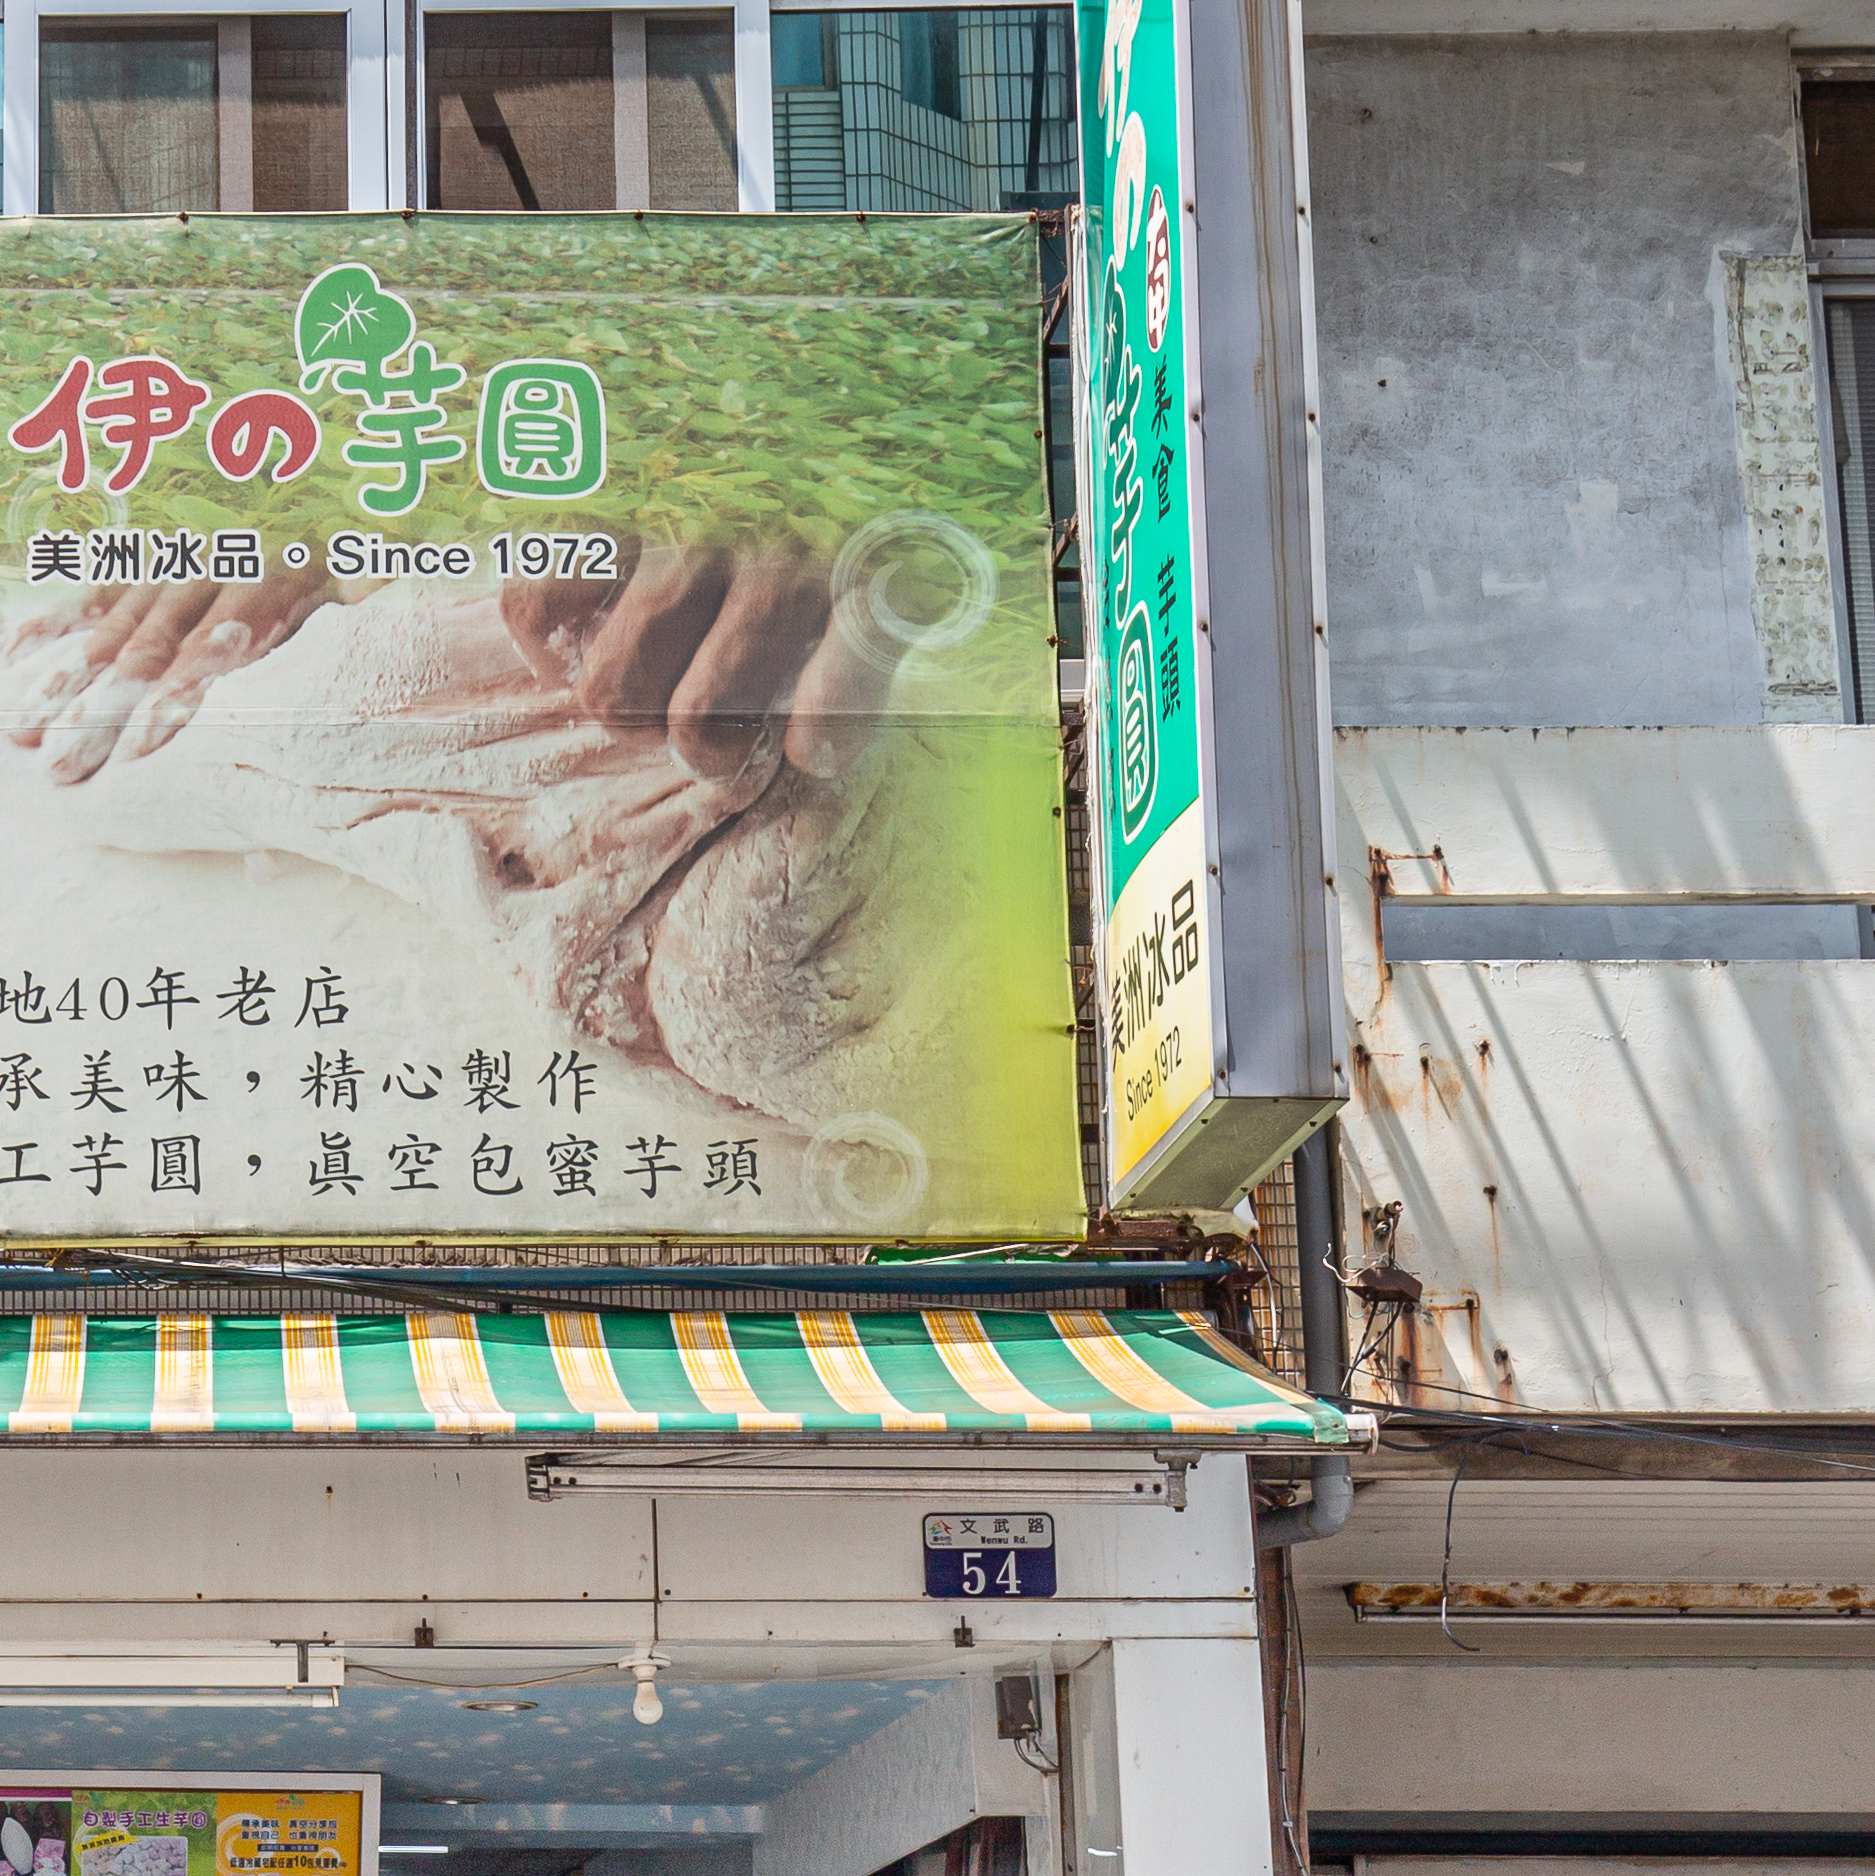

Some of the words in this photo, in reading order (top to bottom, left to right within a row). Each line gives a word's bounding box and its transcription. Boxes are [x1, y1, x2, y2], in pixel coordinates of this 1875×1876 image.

[11, 341, 607, 518] 伊の芋圓
[1151, 353, 1172, 522] 美食
[329, 535, 473, 580] Since
[495, 536, 618, 580] 1972
[1158, 552, 1181, 723] 芋頭
[1111, 879, 1198, 1072] 美洲冰品
[1126, 1067, 1153, 1122] Since
[1154, 1025, 1182, 1089] 1972
[960, 1518, 1044, 1534] 文武路
[980, 1536, 1009, 1544] Wenwu
[1013, 1535, 1028, 1544] Rd.
[962, 1550, 1022, 1595] 54
[83, 1810, 207, 1828] 自製手工生芋圓
